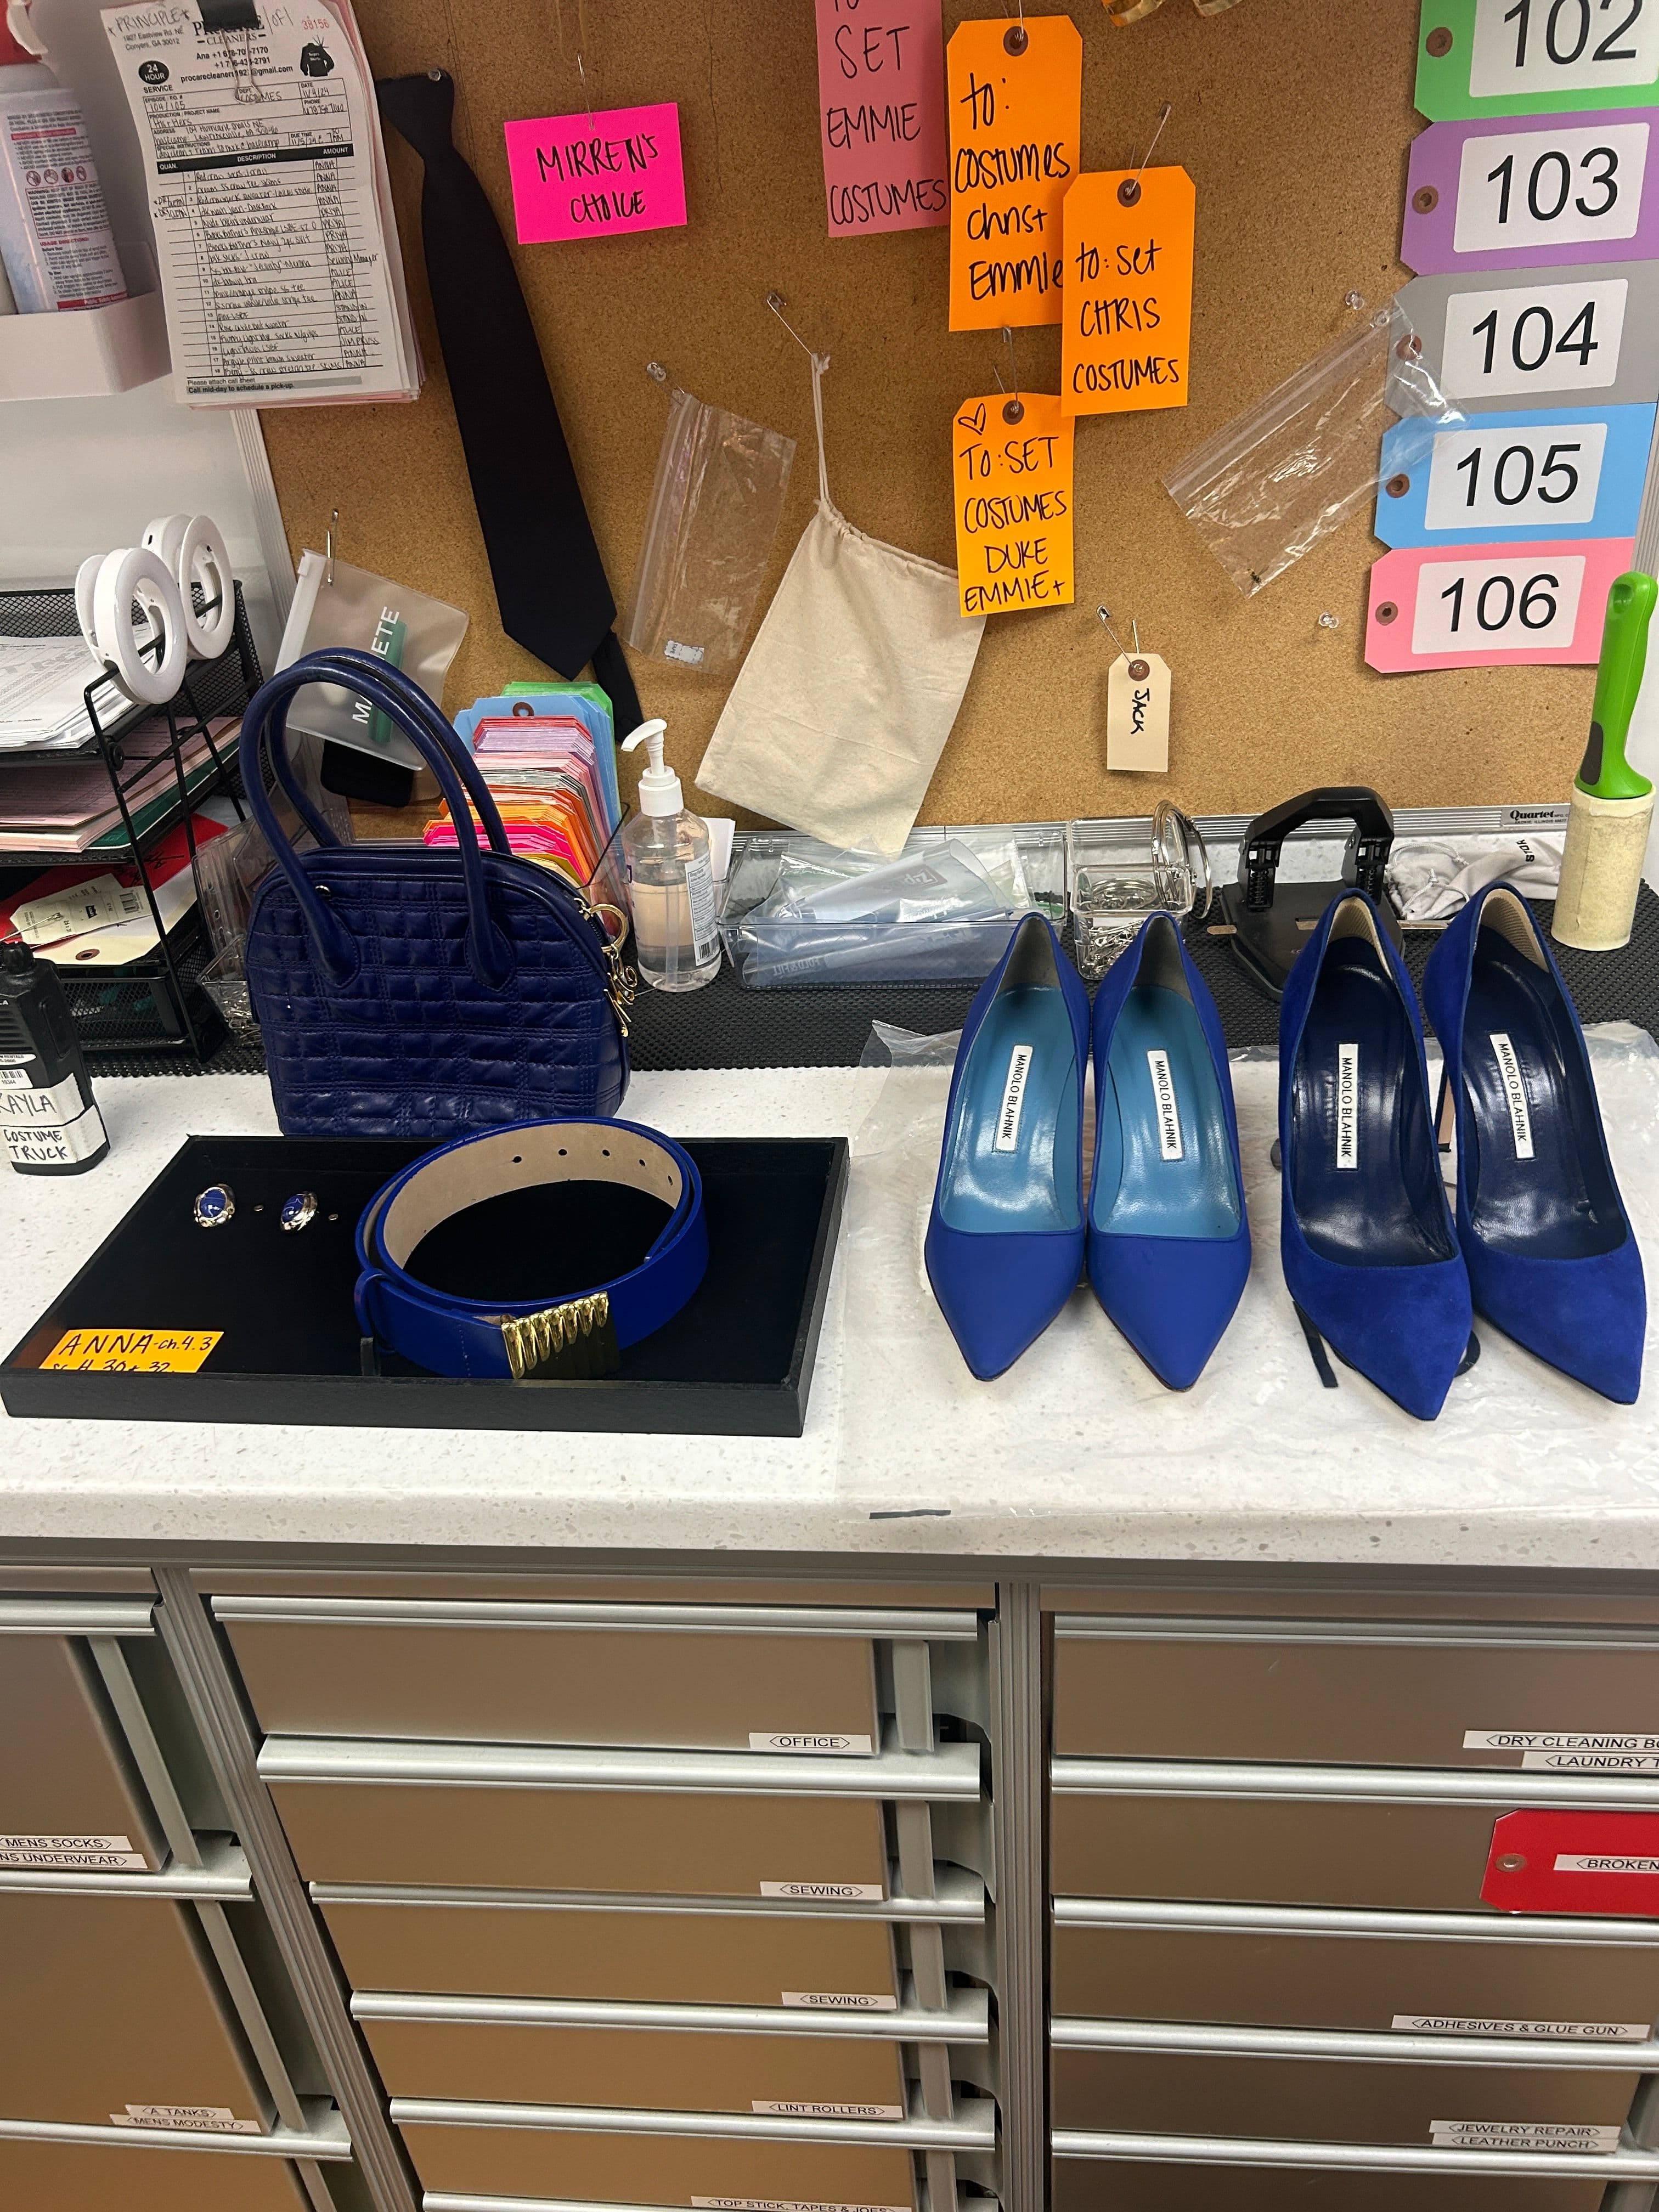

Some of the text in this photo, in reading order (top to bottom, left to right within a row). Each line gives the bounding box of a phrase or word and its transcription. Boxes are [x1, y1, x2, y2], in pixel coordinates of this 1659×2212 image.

[302, 18, 329, 30] 38156
[1504, 0, 1643, 67] 102
[834, 25, 910, 79] SET
[146, 64, 159, 72] 24
[144, 72, 165, 81] HOUR
[143, 84, 173, 93] SERVICE
[826, 103, 921, 150] EMMIE
[237, 153, 276, 163] DESCRIPTION
[323, 146, 349, 155] AMOUNT
[536, 133, 660, 183] MIRREN'S
[1487, 147, 1619, 224] 103
[570, 190, 646, 223] CHOICE
[829, 179, 947, 225] COSTUMES
[1080, 297, 1161, 337] CHRIS
[1472, 302, 1599, 374] 104
[1072, 355, 1180, 394] COSTUMES
[202, 385, 227, 393] mid-day
[1457, 443, 1582, 506] 105
[964, 490, 1068, 534] COSTUMES
[984, 537, 1048, 574] DUKE
[1441, 574, 1560, 633] 106
[1130, 688, 1150, 735] JACK
[1510, 810, 1554, 821] Quartet
[1001, 1053, 1028, 1139] MANOLO BLAHNIK
[1498, 1043, 1527, 1142] MANOLO BLAHNIK
[1155, 1060, 1177, 1149] MANOLO BLAHNIK
[1340, 1057, 1353, 1157] MANOLO BLAHNIK
[3, 1128, 63, 1143] COSTUME
[9, 1144, 69, 1161] TRUCK
[58, 1333, 154, 1356] ANNA
[779, 1737, 840, 1747] OFFICE
[1498, 1735, 1638, 1748] DRY CLEANING
[1556, 1756, 1646, 1768] LAUNDRY
[5, 1838, 104, 1848] MENS SOCKS
[22, 1854, 119, 1864] UNDERWEAR
[789, 1885, 854, 1895] SEWING
[809, 1995, 870, 2005] SEWING
[1420, 2019, 1619, 2036] ADHESIVES & GLUE GUN
[167, 2107, 210, 2117] TANKS
[777, 2103, 877, 2115] LINT ROLLERS
[134, 2117, 236, 2128] MENS MODESTY
[1455, 2123, 1593, 2136] JEWELRY REPAIR
[1459, 2136, 1590, 2149] LEATHER PUNCH
[716, 2199, 742, 2207] TOP
[746, 2200, 789, 2211] STICK,
[793, 2203, 826, 2212] TAPES
